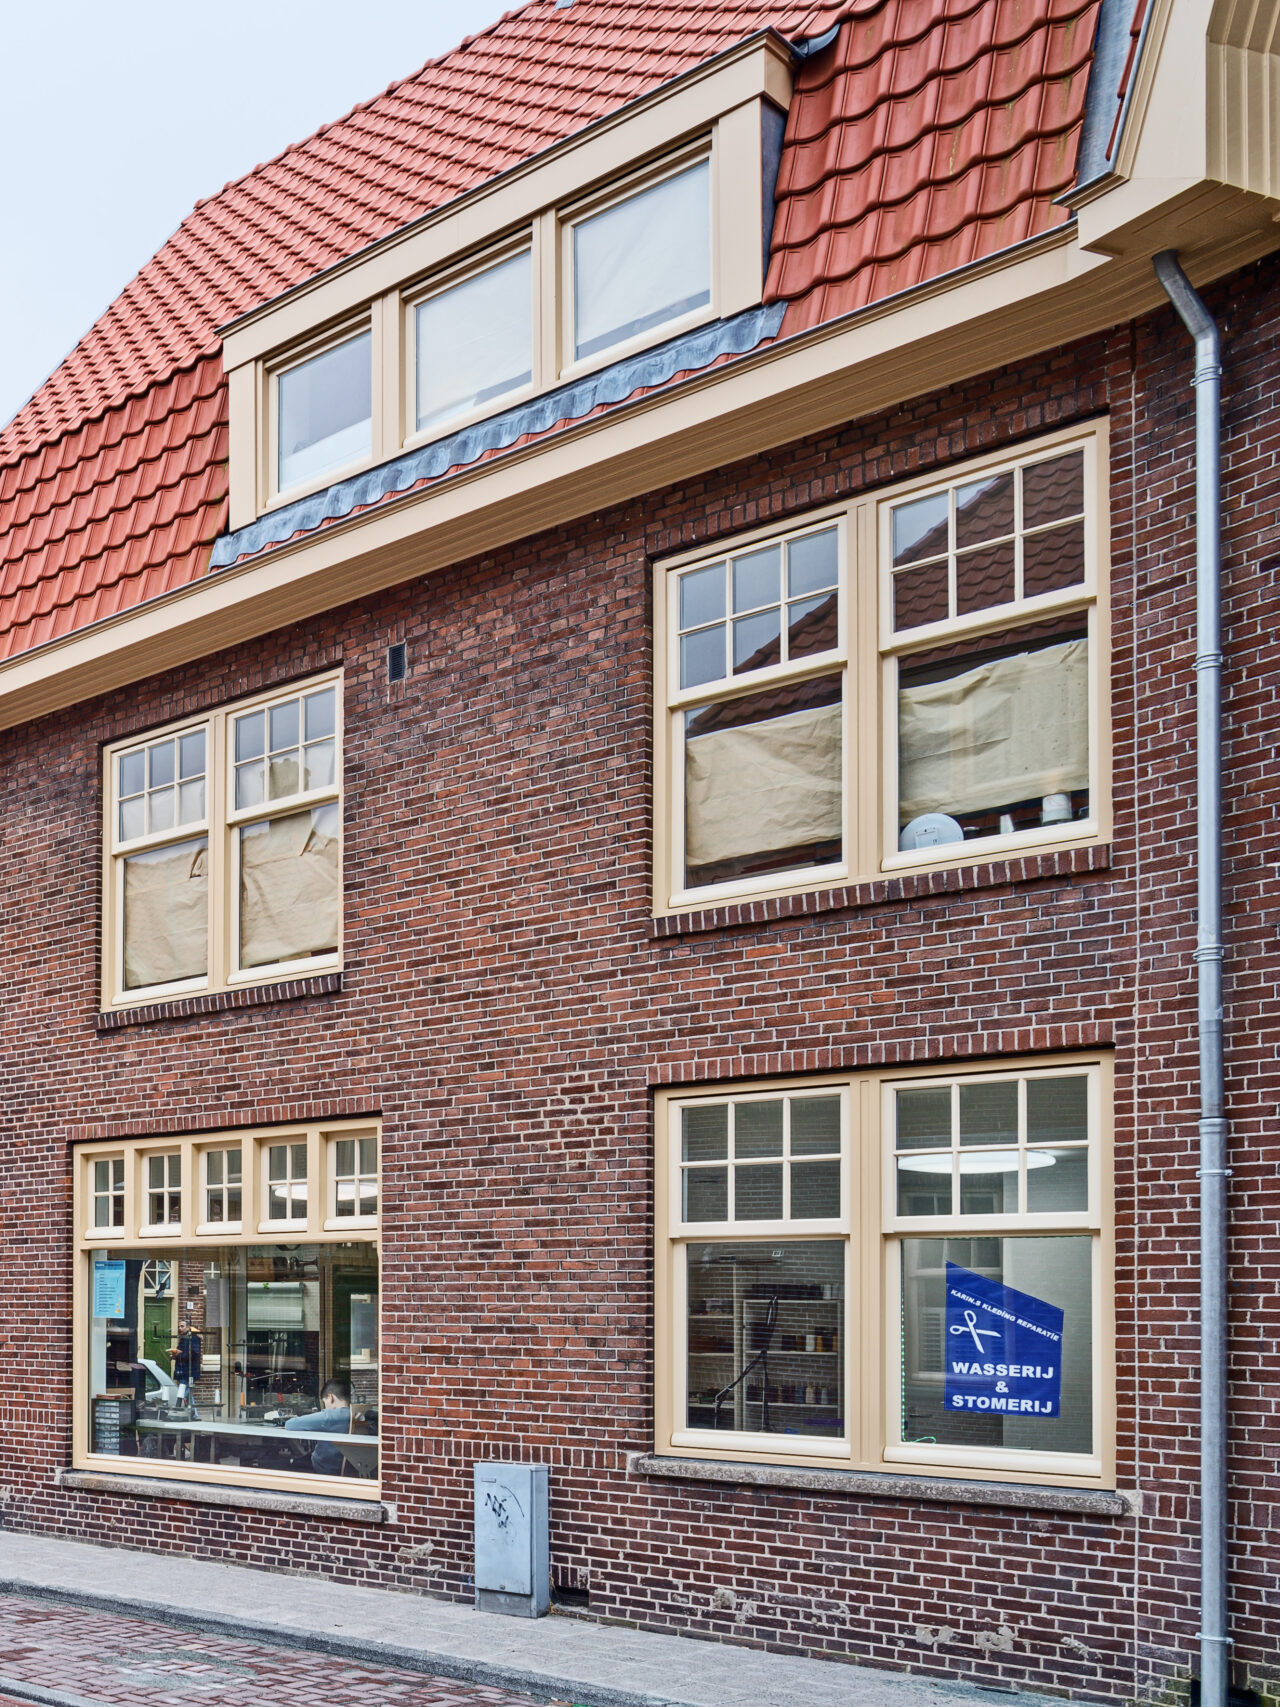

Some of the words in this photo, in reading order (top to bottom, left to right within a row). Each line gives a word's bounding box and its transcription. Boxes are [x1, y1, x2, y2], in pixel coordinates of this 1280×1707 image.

[952, 1361, 1054, 1379] WASSERIJ
[995, 1381, 1009, 1393] &
[952, 1394, 1053, 1414] STOMERIJ
